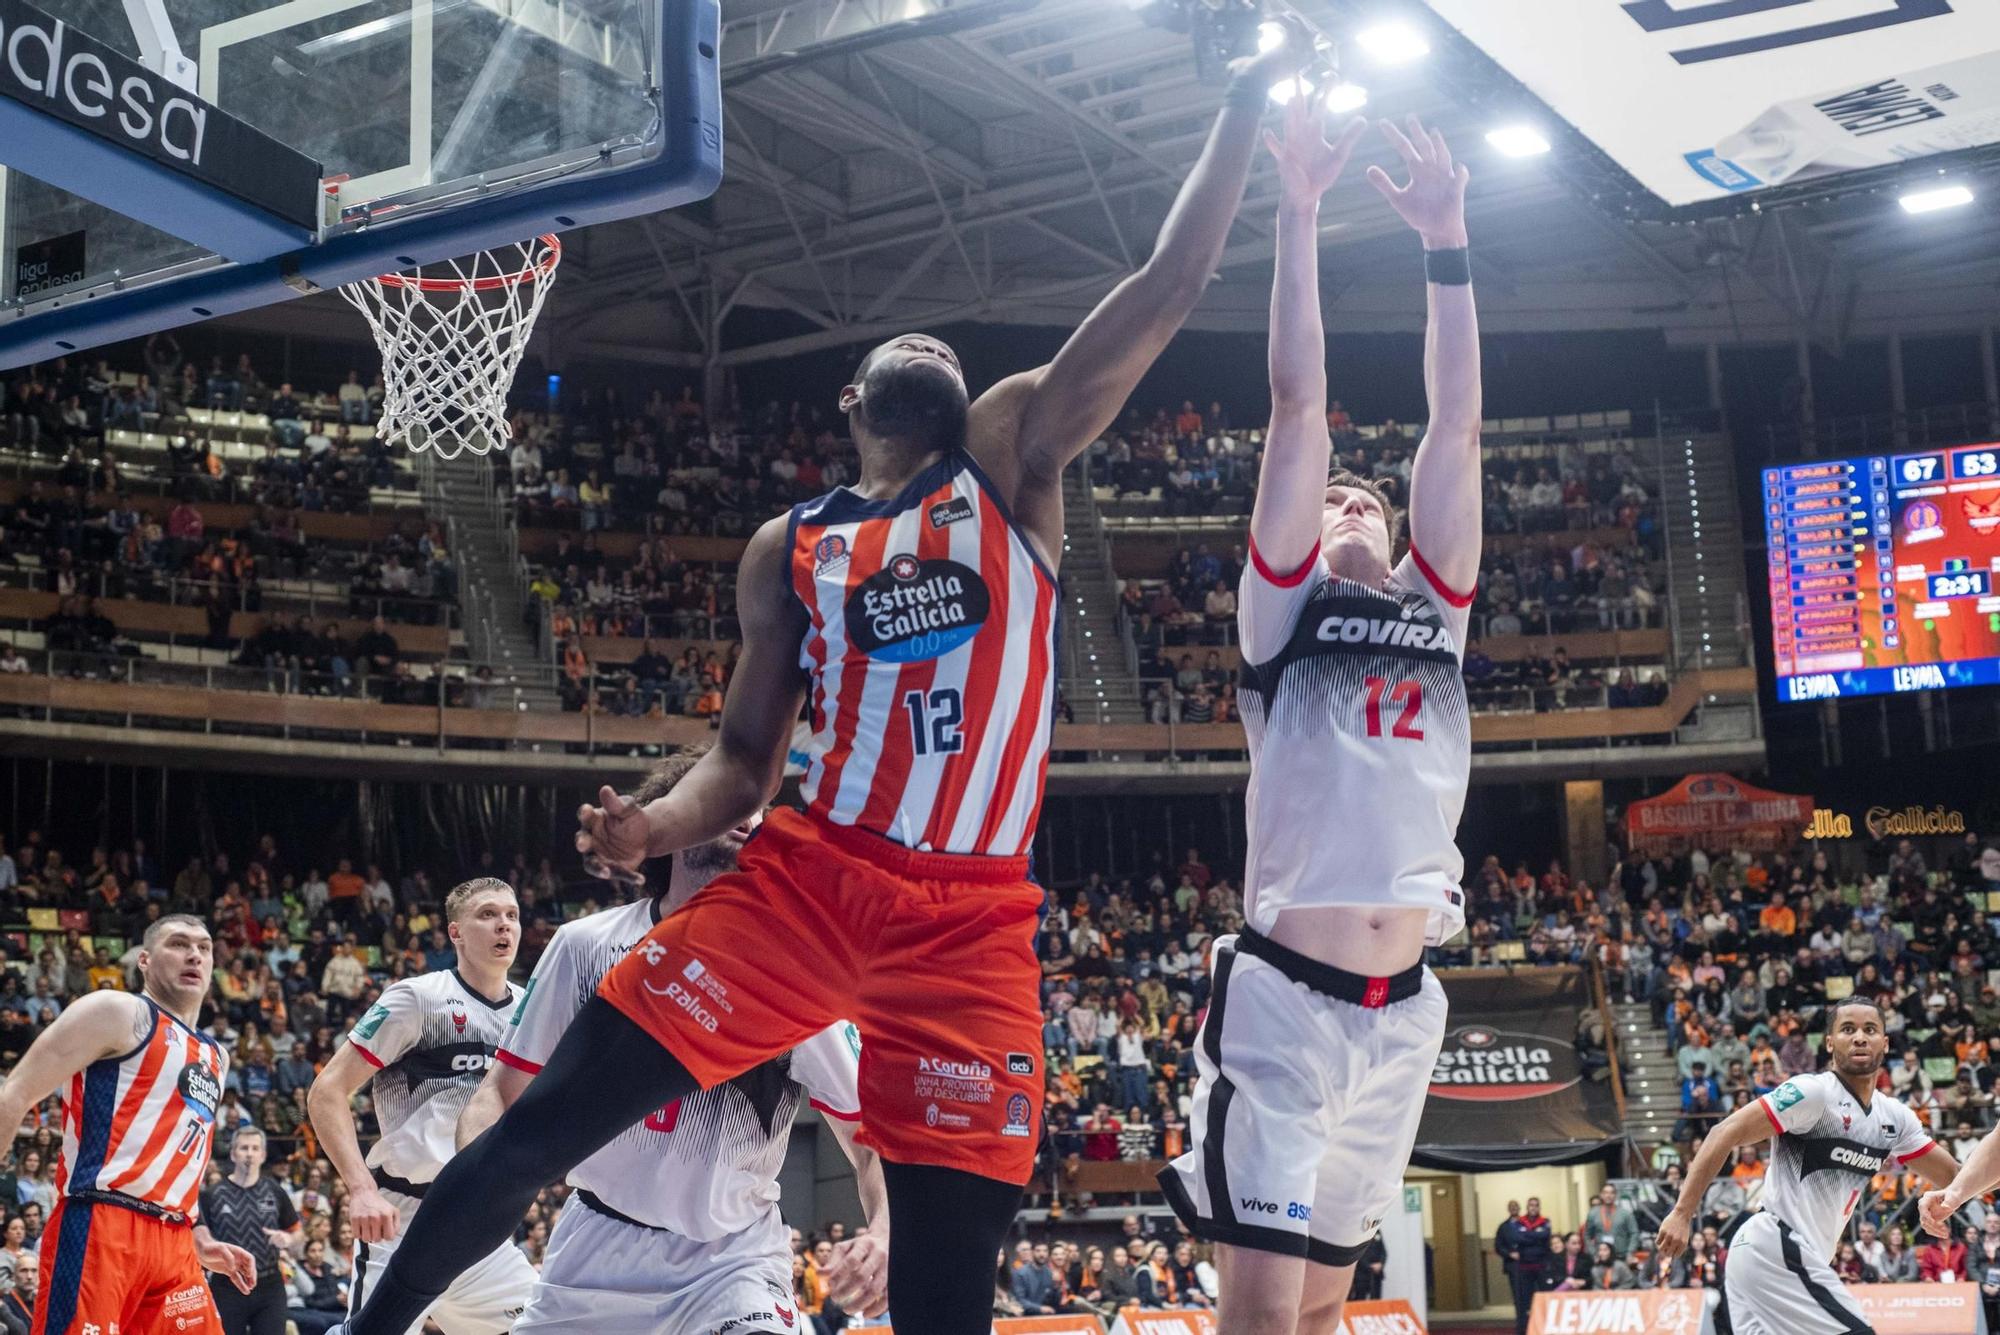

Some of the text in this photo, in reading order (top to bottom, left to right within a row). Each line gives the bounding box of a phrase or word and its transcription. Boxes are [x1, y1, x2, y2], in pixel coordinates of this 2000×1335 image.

[0, 18, 207, 165] desa
[20, 262, 48, 281] liga
[1903, 457, 1938, 482] 67
[1963, 452, 1998, 476] 53
[863, 576, 964, 617] Estrella
[1934, 573, 1983, 598] 2:31
[873, 600, 966, 641] Galicia
[1316, 616, 1453, 653] COVIRA
[1789, 674, 1841, 700] LEYMA
[1893, 665, 1946, 691] LEYMA
[1363, 675, 1424, 741] 12
[903, 688, 964, 756] 12
[1865, 804, 1966, 840] Galicia
[658, 980, 719, 1033] galicia
[931, 1057, 992, 1078] Coruña
[1010, 1061, 1030, 1073] acb
[1438, 1046, 1552, 1066] strella
[187, 1068, 220, 1099] Estrella
[915, 1086, 991, 1103] POR DESCUBRIR
[941, 1078, 995, 1093] PROVINCIA
[1830, 1146, 1883, 1172] COVIRA
[1240, 1197, 1279, 1214] vive
[1544, 1297, 1646, 1335] LEYMA
